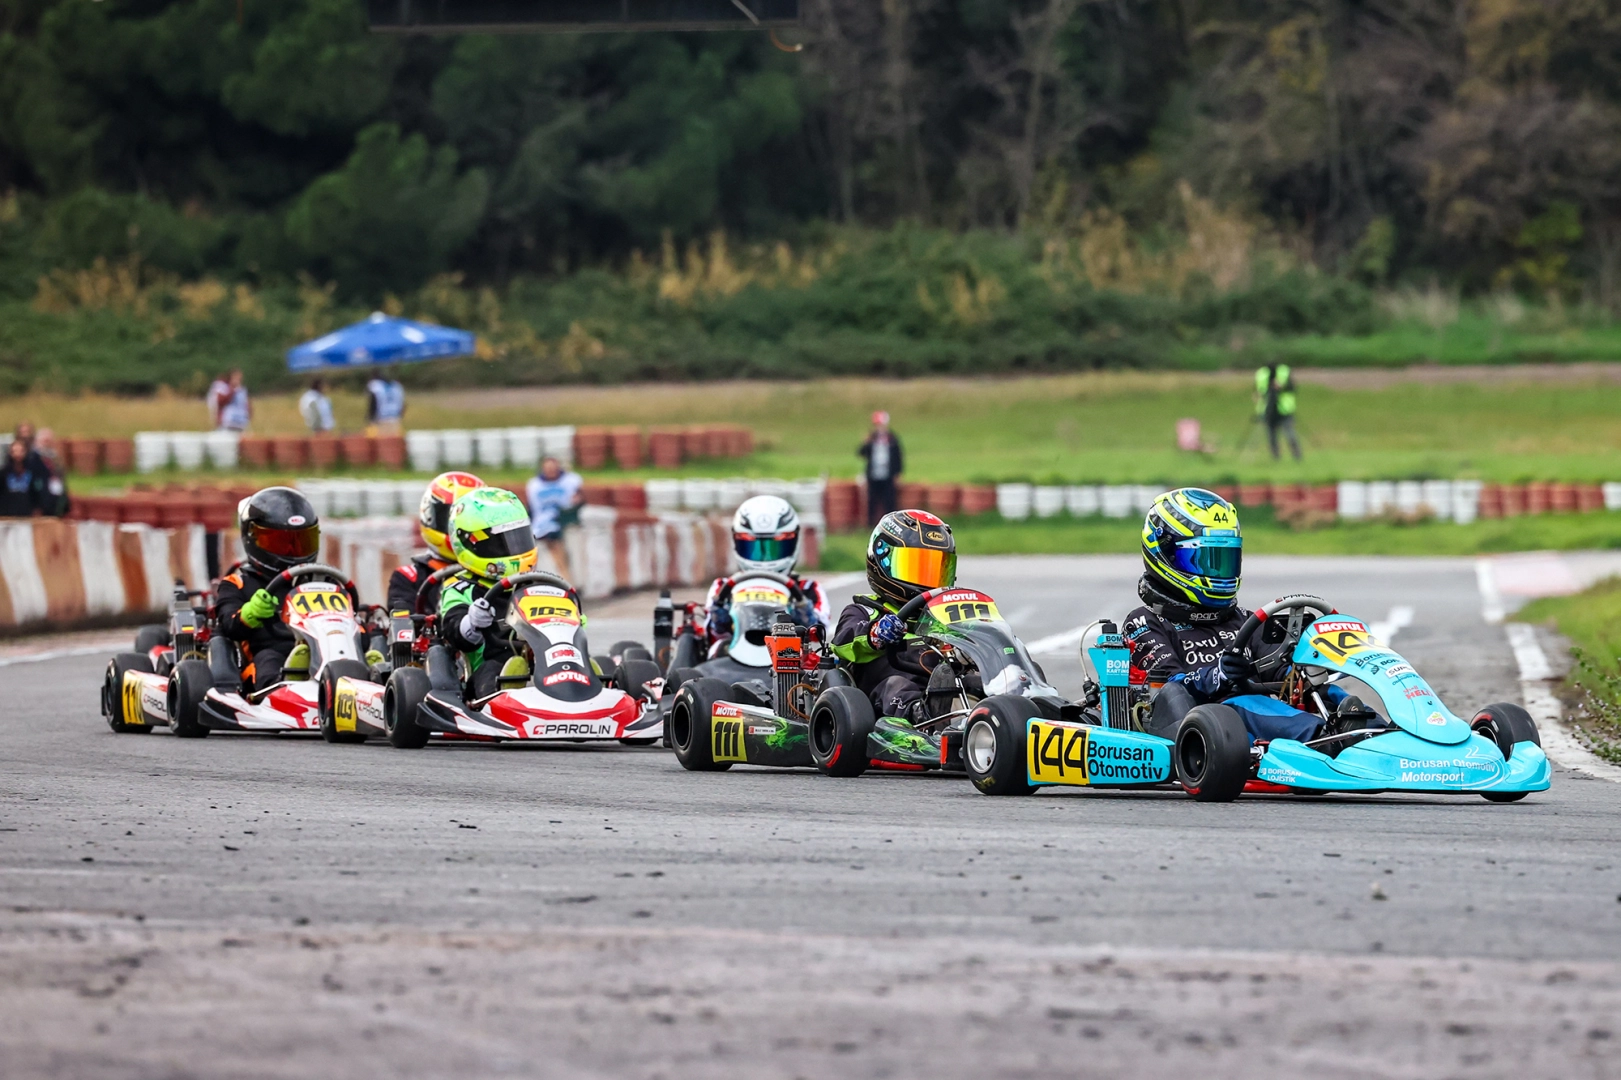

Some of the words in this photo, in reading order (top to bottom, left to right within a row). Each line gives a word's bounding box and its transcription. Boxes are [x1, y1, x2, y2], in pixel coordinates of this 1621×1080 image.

[1213, 512, 1228, 523] 44
[296, 593, 348, 613] 110
[942, 593, 978, 602] MOTUL
[529, 606, 572, 617] 103
[944, 603, 991, 622] 111
[1318, 622, 1365, 633] MOTUL
[1106, 660, 1129, 669] BOM
[546, 672, 588, 685] MOTUL
[715, 706, 738, 716] MOTUL
[545, 724, 611, 735] PAROLIN
[714, 721, 741, 757] 111
[1031, 724, 1088, 779] 144
[1087, 741, 1154, 761] Borusan
[1088, 760, 1163, 780] Otomotiv
[1400, 758, 1450, 769] Borusan
[1452, 758, 1495, 772] Otomotiv
[1267, 768, 1302, 777] BORUSAN
[1401, 771, 1465, 784] Motorsport
